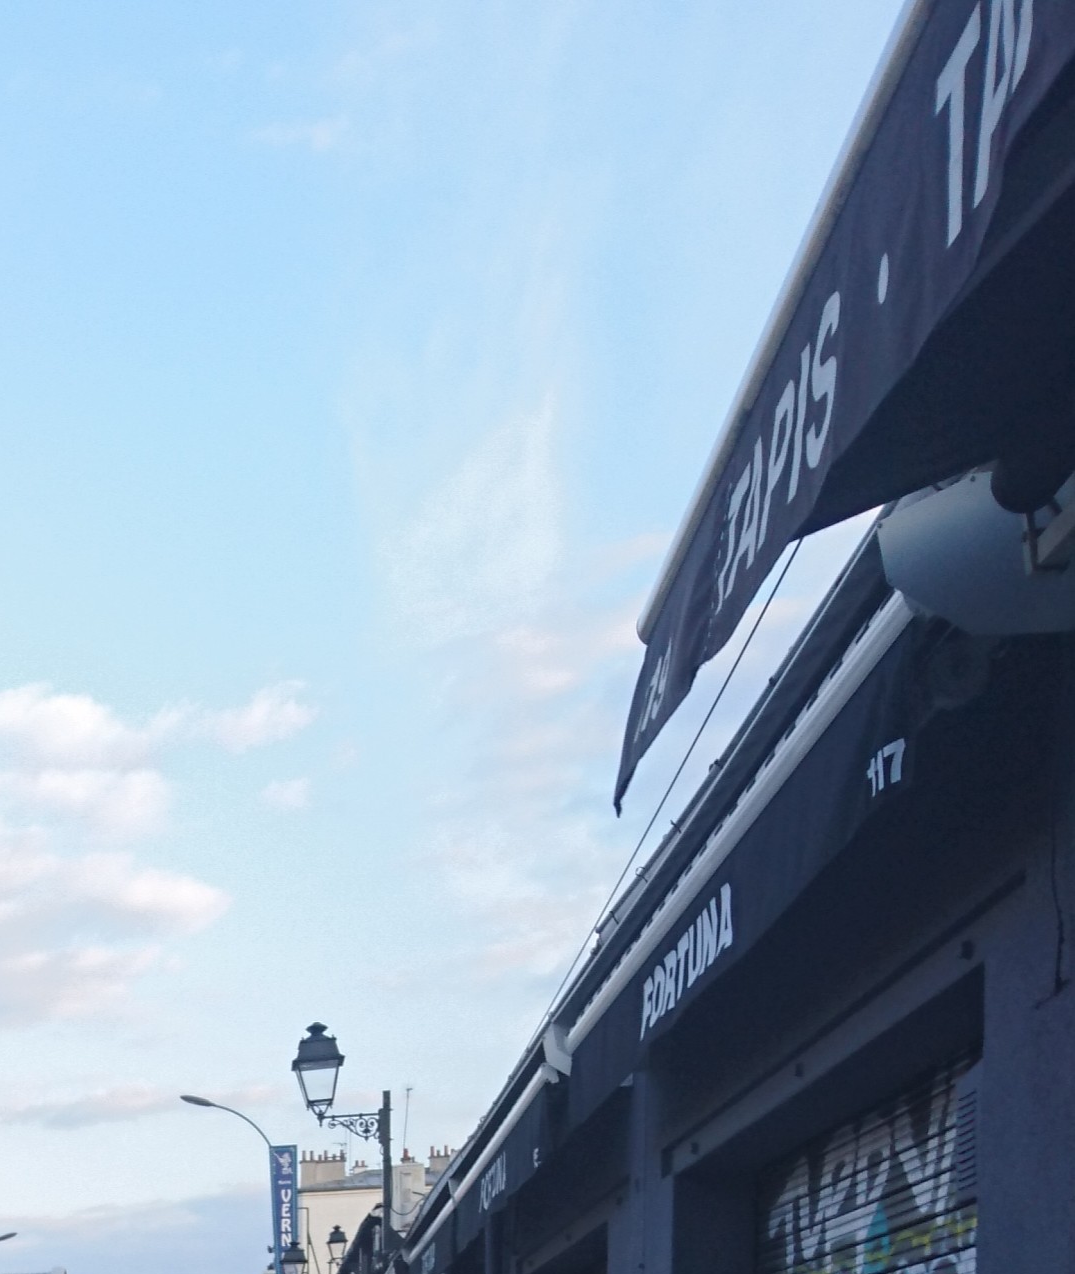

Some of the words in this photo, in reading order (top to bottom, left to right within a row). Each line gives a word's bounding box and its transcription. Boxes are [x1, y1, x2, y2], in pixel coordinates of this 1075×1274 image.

[715, 290, 841, 616] TAPIS
[867, 738, 906, 797] 117
[640, 882, 734, 1042] FORTUNA
